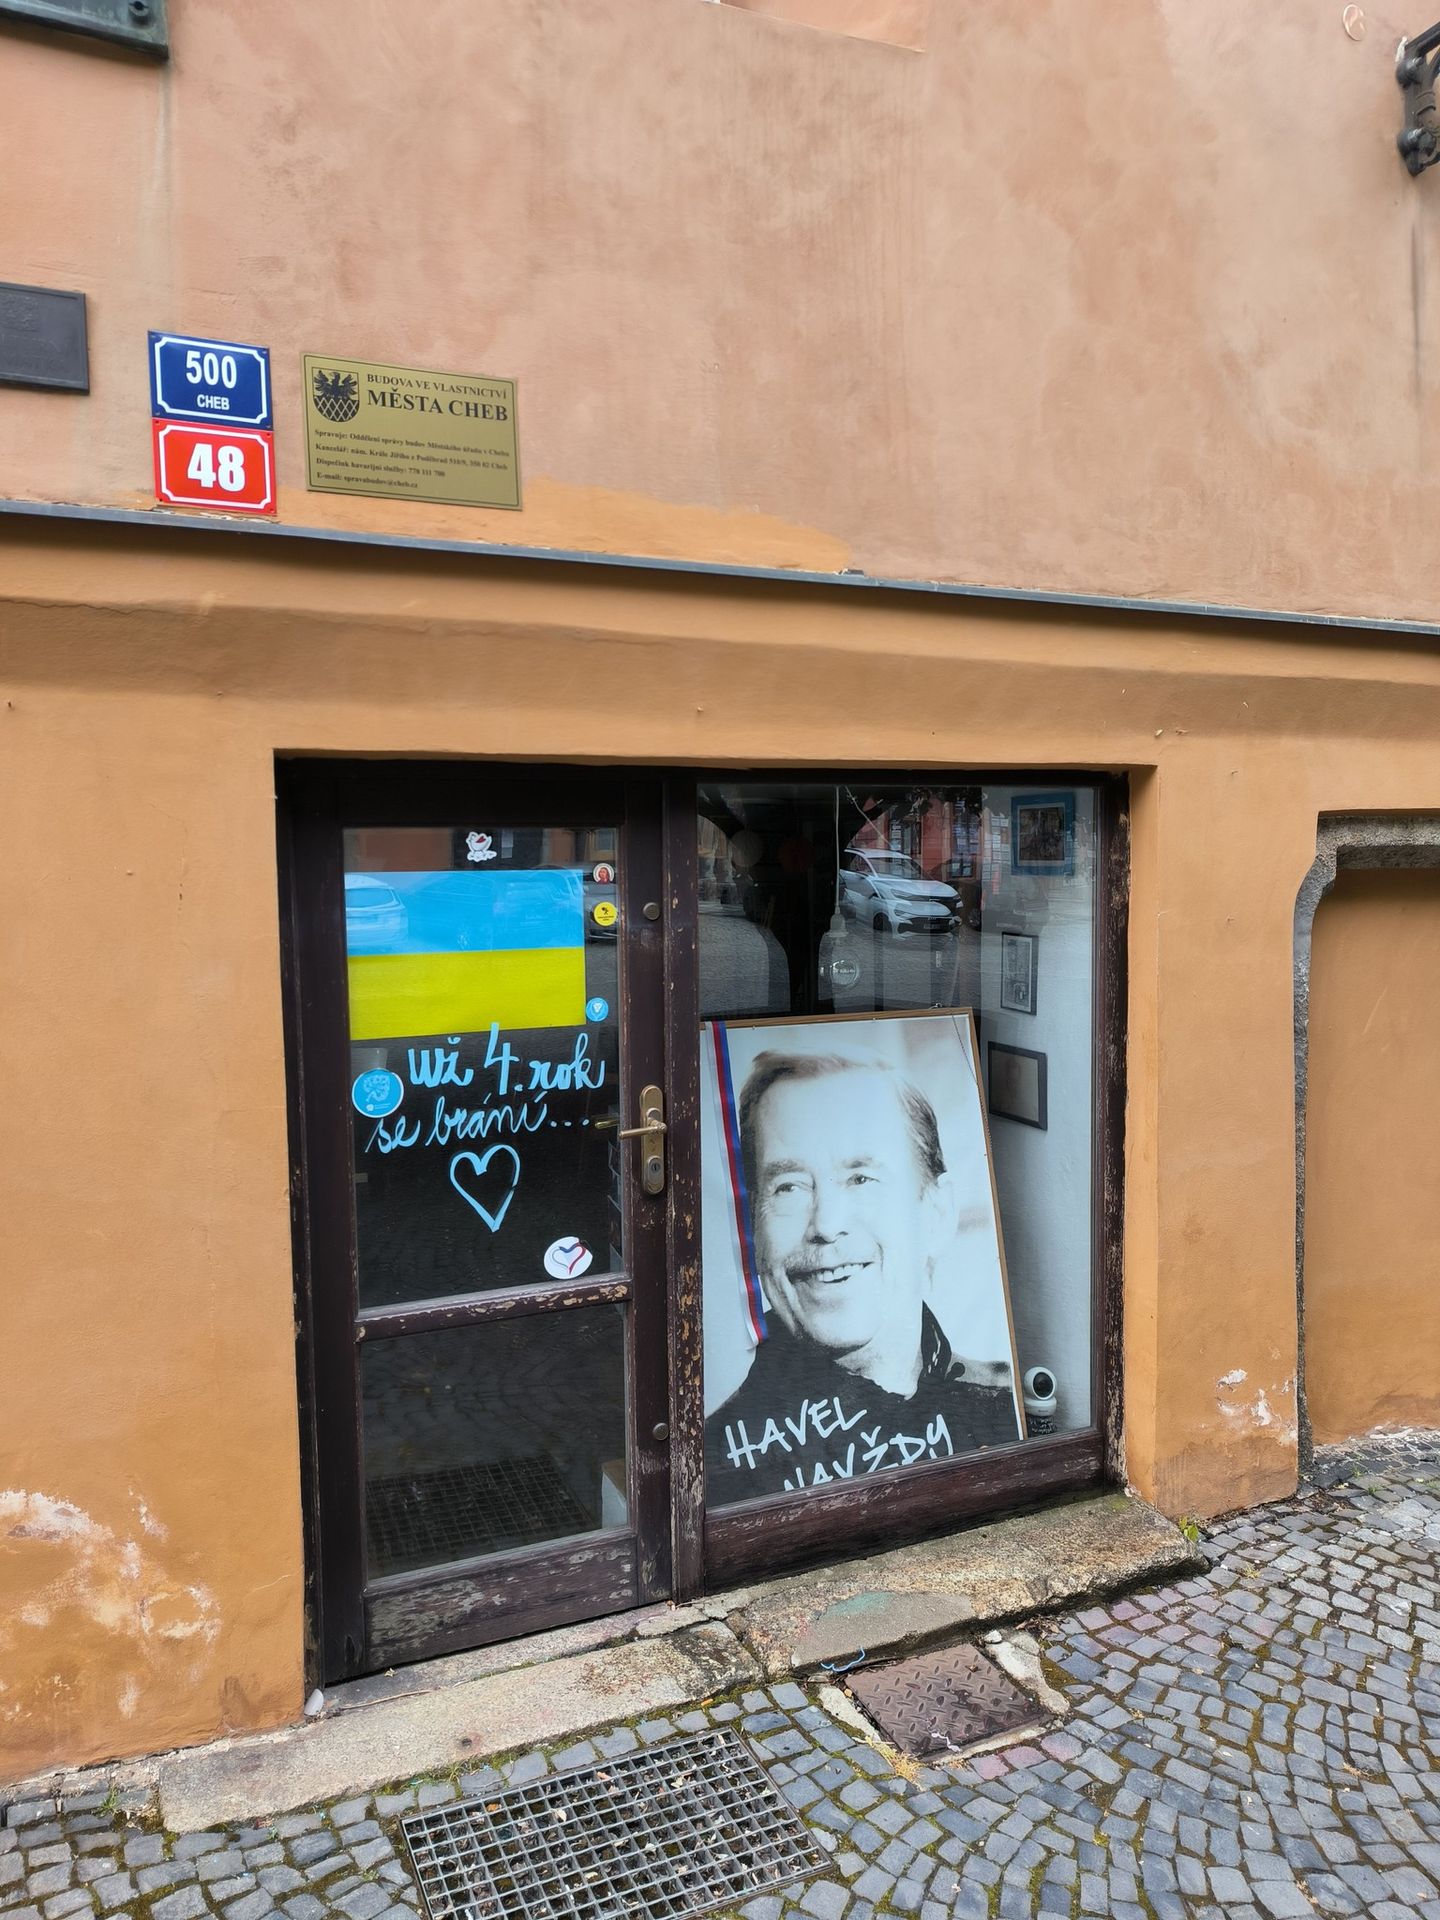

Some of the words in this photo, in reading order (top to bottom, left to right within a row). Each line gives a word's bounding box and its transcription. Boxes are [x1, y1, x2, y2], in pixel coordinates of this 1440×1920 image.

[186, 350, 237, 388] 500
[367, 374, 413, 388] BUDOVA
[415, 380, 431, 390] VE
[433, 382, 507, 399] VLASTNICTVÍ
[197, 395, 230, 410] CHEB
[367, 388, 443, 414] MĚSTA
[448, 400, 508, 421] CHEB
[314, 429, 348, 440] Spravuje:
[350, 432, 380, 442] Oddělení
[381, 437, 404, 446] správy
[315, 443, 349, 453] Kancelář:
[369, 449, 388, 457] Krále
[187, 443, 246, 492] 48
[316, 457, 349, 467] Dispečink
[351, 462, 382, 471] havarijní
[316, 471, 342, 481] E-mail:
[365, 1114, 420, 1154] se
[725, 1397, 867, 1469] HAVEL
